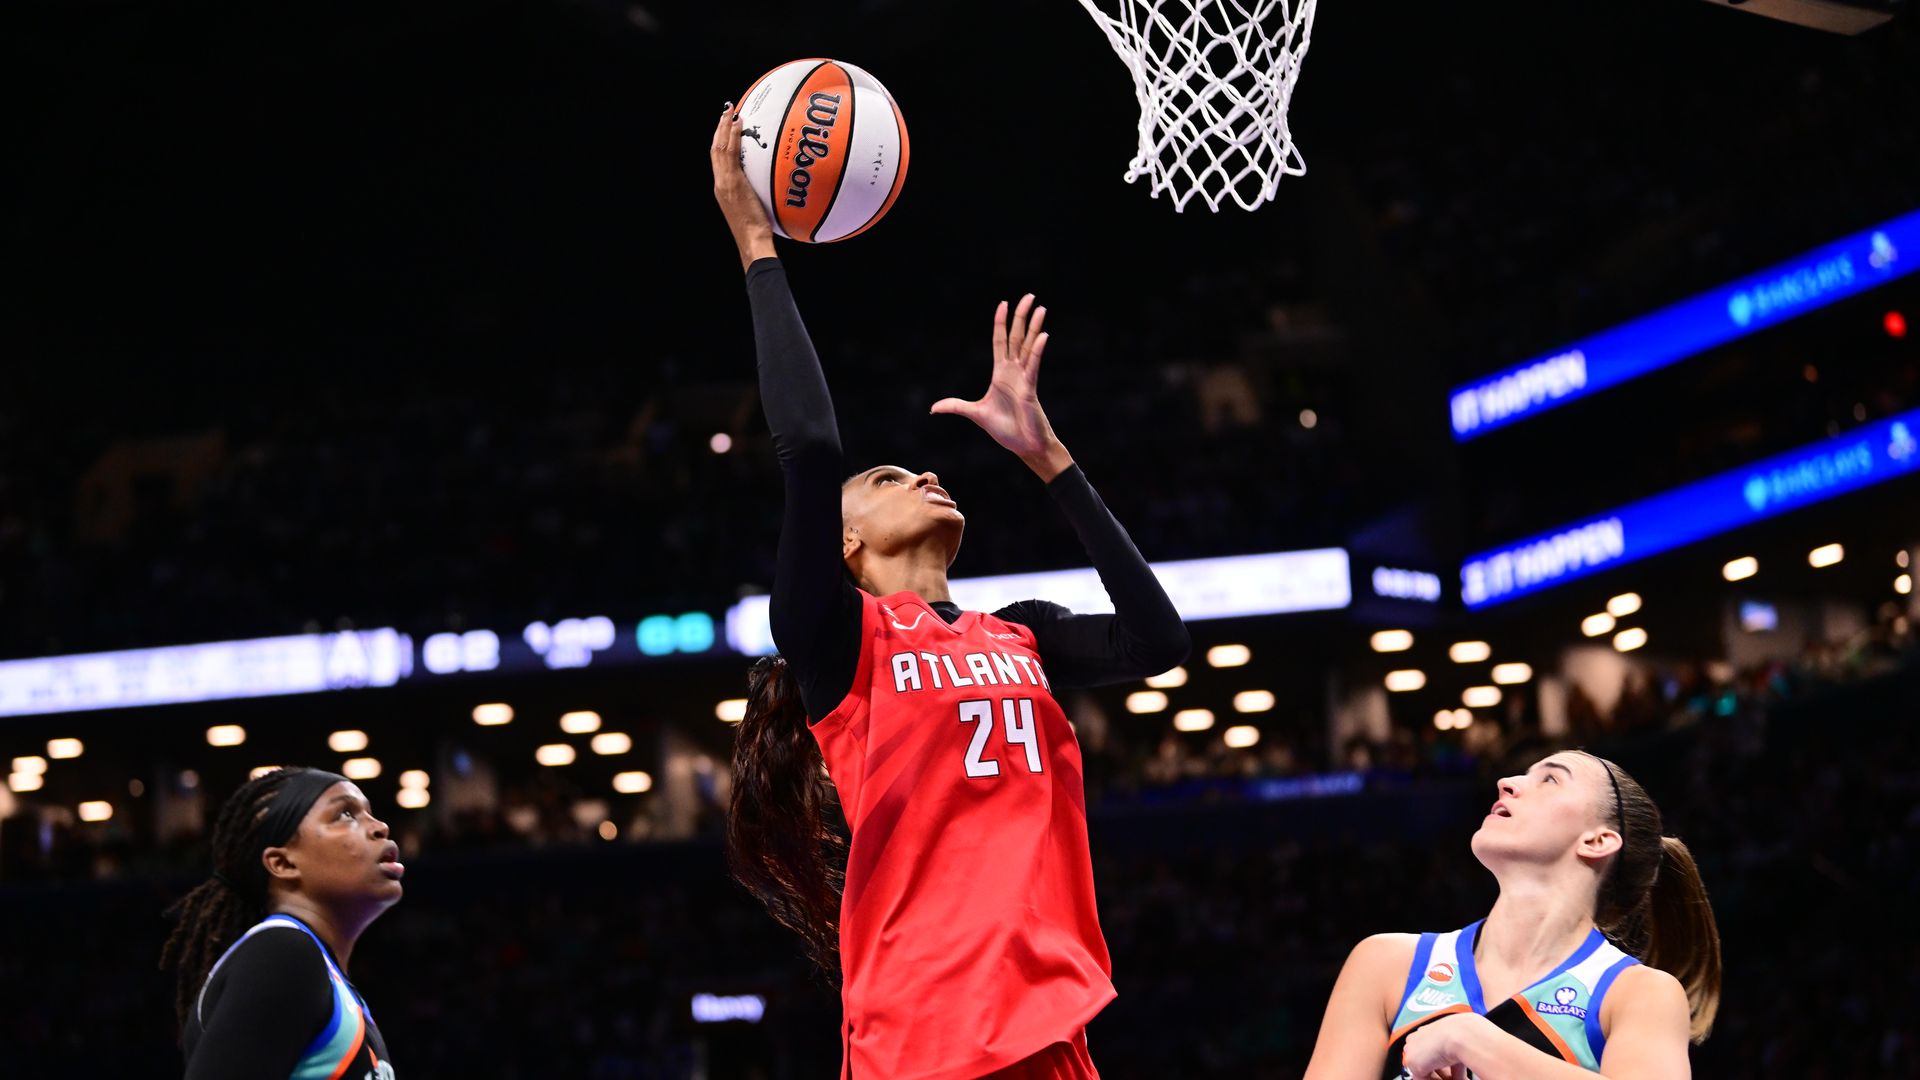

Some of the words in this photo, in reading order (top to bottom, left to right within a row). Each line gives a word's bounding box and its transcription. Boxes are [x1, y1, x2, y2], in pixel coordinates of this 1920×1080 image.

[785, 92, 842, 208] Wilson
[958, 698, 1043, 778] 24
[1537, 1002, 1587, 1018] BARCLAYS
